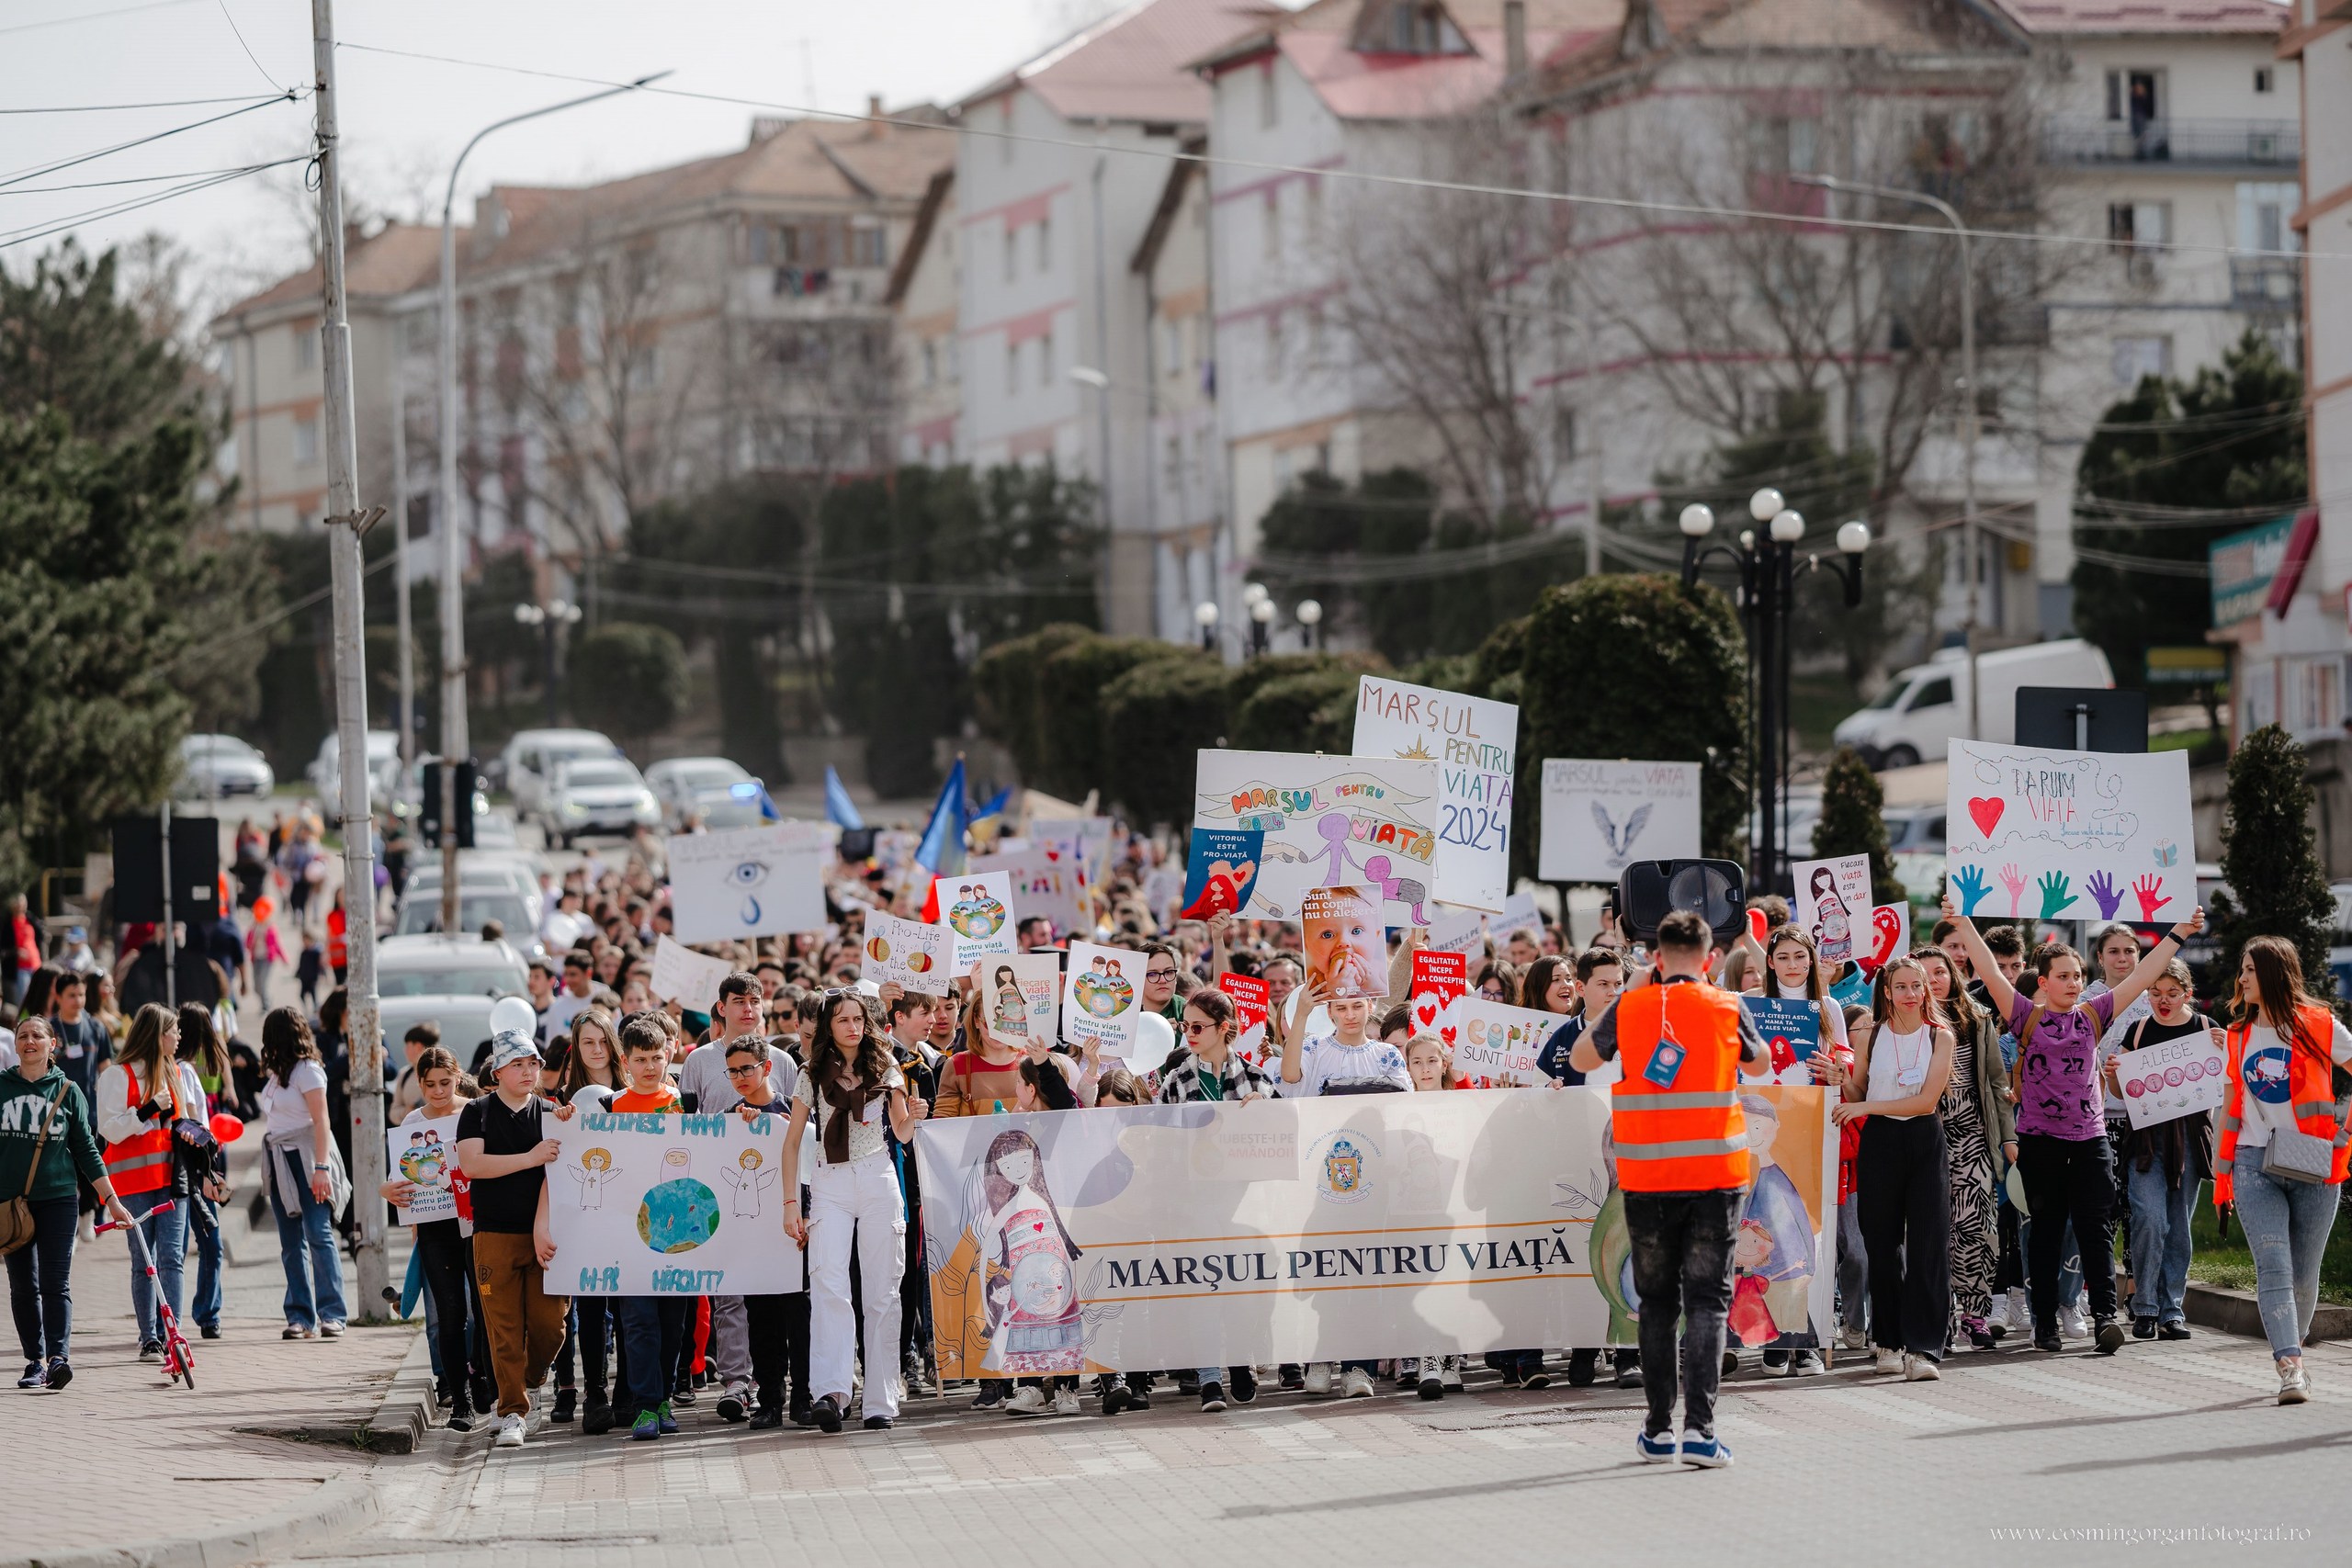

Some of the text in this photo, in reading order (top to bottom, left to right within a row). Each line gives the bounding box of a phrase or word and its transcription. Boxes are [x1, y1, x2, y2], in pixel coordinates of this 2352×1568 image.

[1362, 682, 1481, 739] MARȘUL
[1444, 738, 1514, 775] PENTRU
[1231, 784, 1385, 817] MARȘUL PENTRU
[1240, 814, 1283, 831] 2024
[1438, 804, 1506, 852] 2024
[1203, 851, 1248, 860] PRO-VIAȚĂ
[1840, 859, 1864, 869] Fiecare
[1842, 883, 1856, 891] este
[1305, 891, 1332, 901] Sunt
[1853, 891, 1867, 901] dar
[1304, 897, 1355, 910] un copil,
[1305, 911, 1320, 919] nu
[891, 919, 941, 942] Pro-Life
[896, 942, 906, 954] is
[957, 944, 983, 953] Pentru
[958, 952, 982, 960] Pentru
[1419, 955, 1460, 965] EGALITATEA
[889, 956, 906, 971] the
[1429, 964, 1453, 975] ÎNCEPE
[872, 965, 946, 991] only way to bee
[1015, 977, 1051, 987] Fiecare
[1429, 975, 1464, 987] CONCEPȚIE
[1225, 978, 1264, 993] EGALITATEA
[1029, 993, 1051, 1001] este
[1233, 987, 1257, 1000] ÎNCEPE
[1034, 1006, 1051, 1015] dar
[1074, 1016, 1100, 1028] Pentru
[1073, 1023, 1098, 1035] Pentru
[1463, 1045, 1504, 1066] SUNT
[2140, 1041, 2194, 1071] ALEGE
[1, 1094, 64, 1134] NYC
[408, 1190, 434, 1199] Pentru
[410, 1198, 435, 1206] Pentru
[411, 1205, 436, 1213] Pentru
[1286, 1244, 1448, 1280] PENTRU
